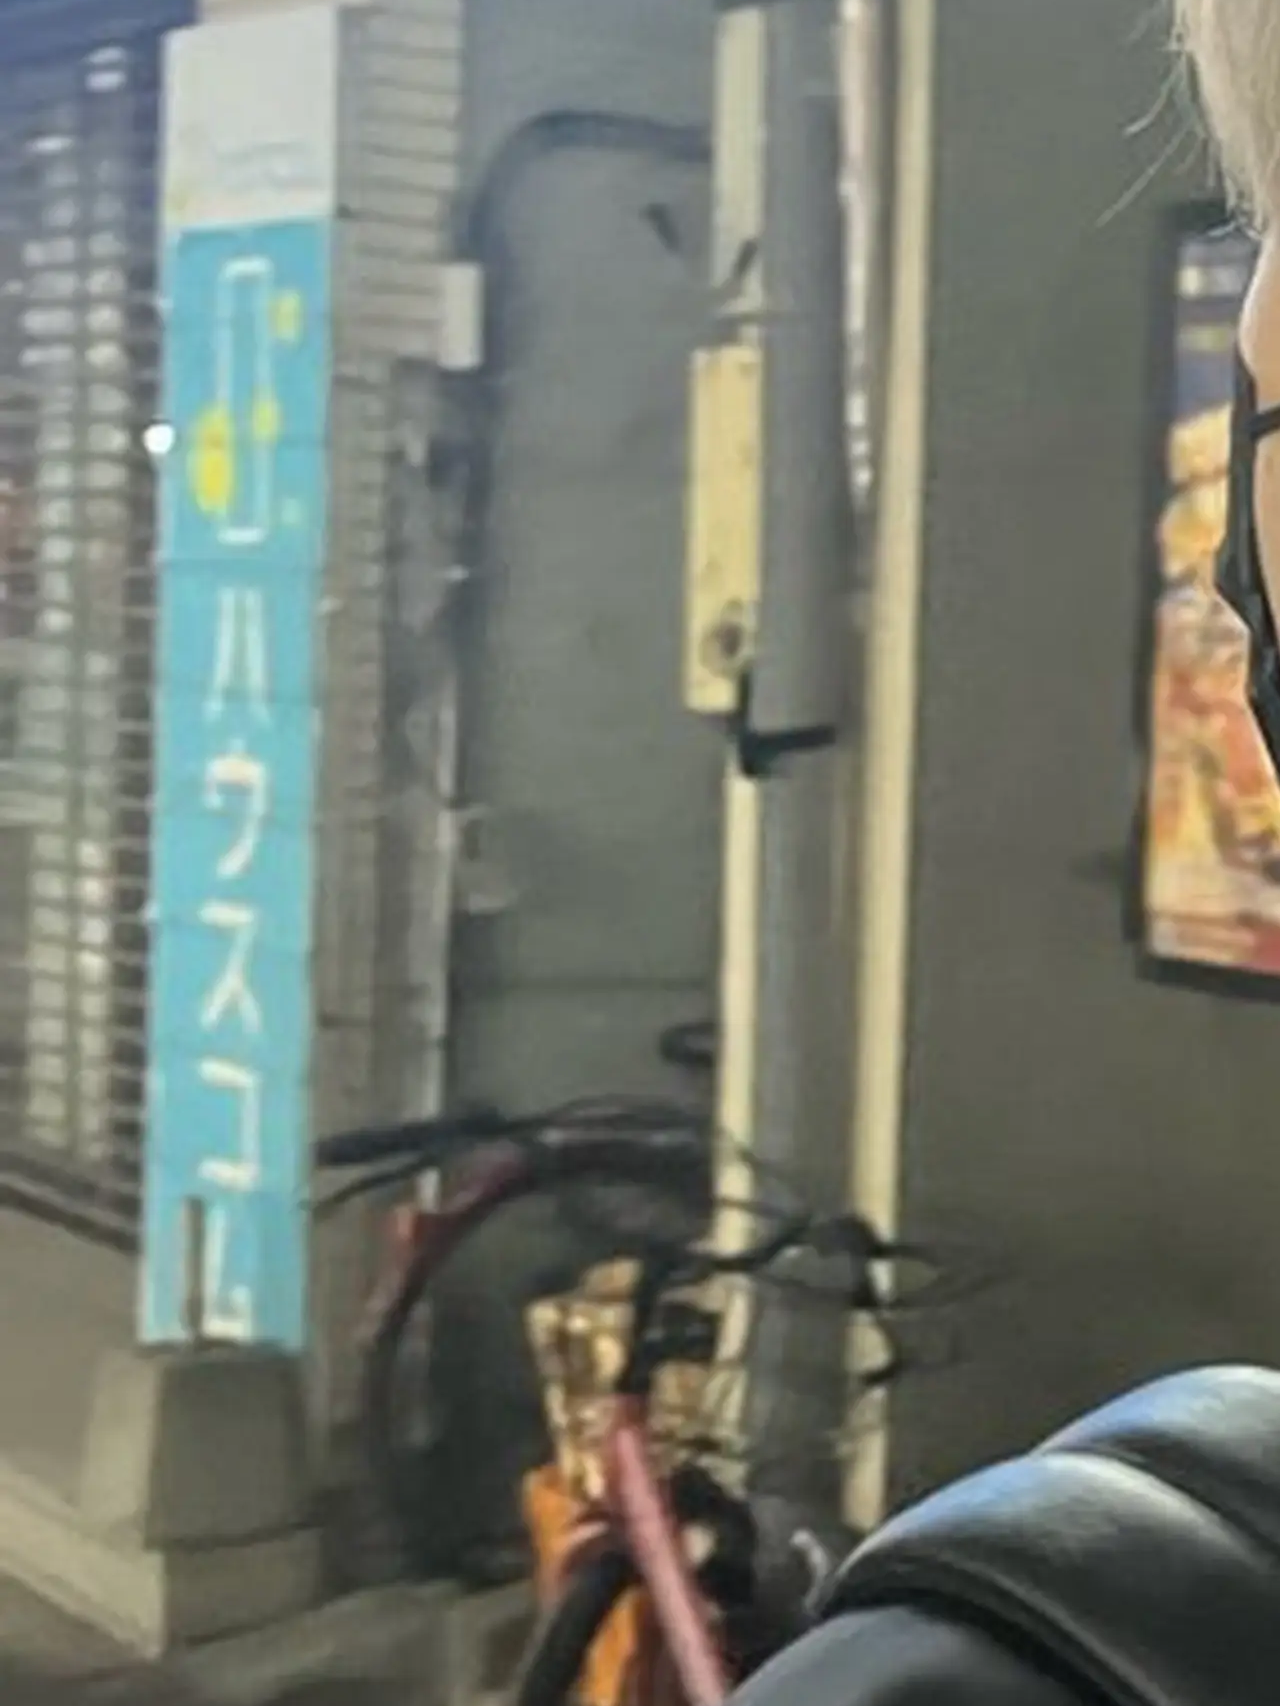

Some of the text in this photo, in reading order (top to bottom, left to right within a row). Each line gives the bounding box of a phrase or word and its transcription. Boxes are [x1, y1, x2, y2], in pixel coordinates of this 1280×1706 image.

[198, 587, 270, 1341] ハウスコム
